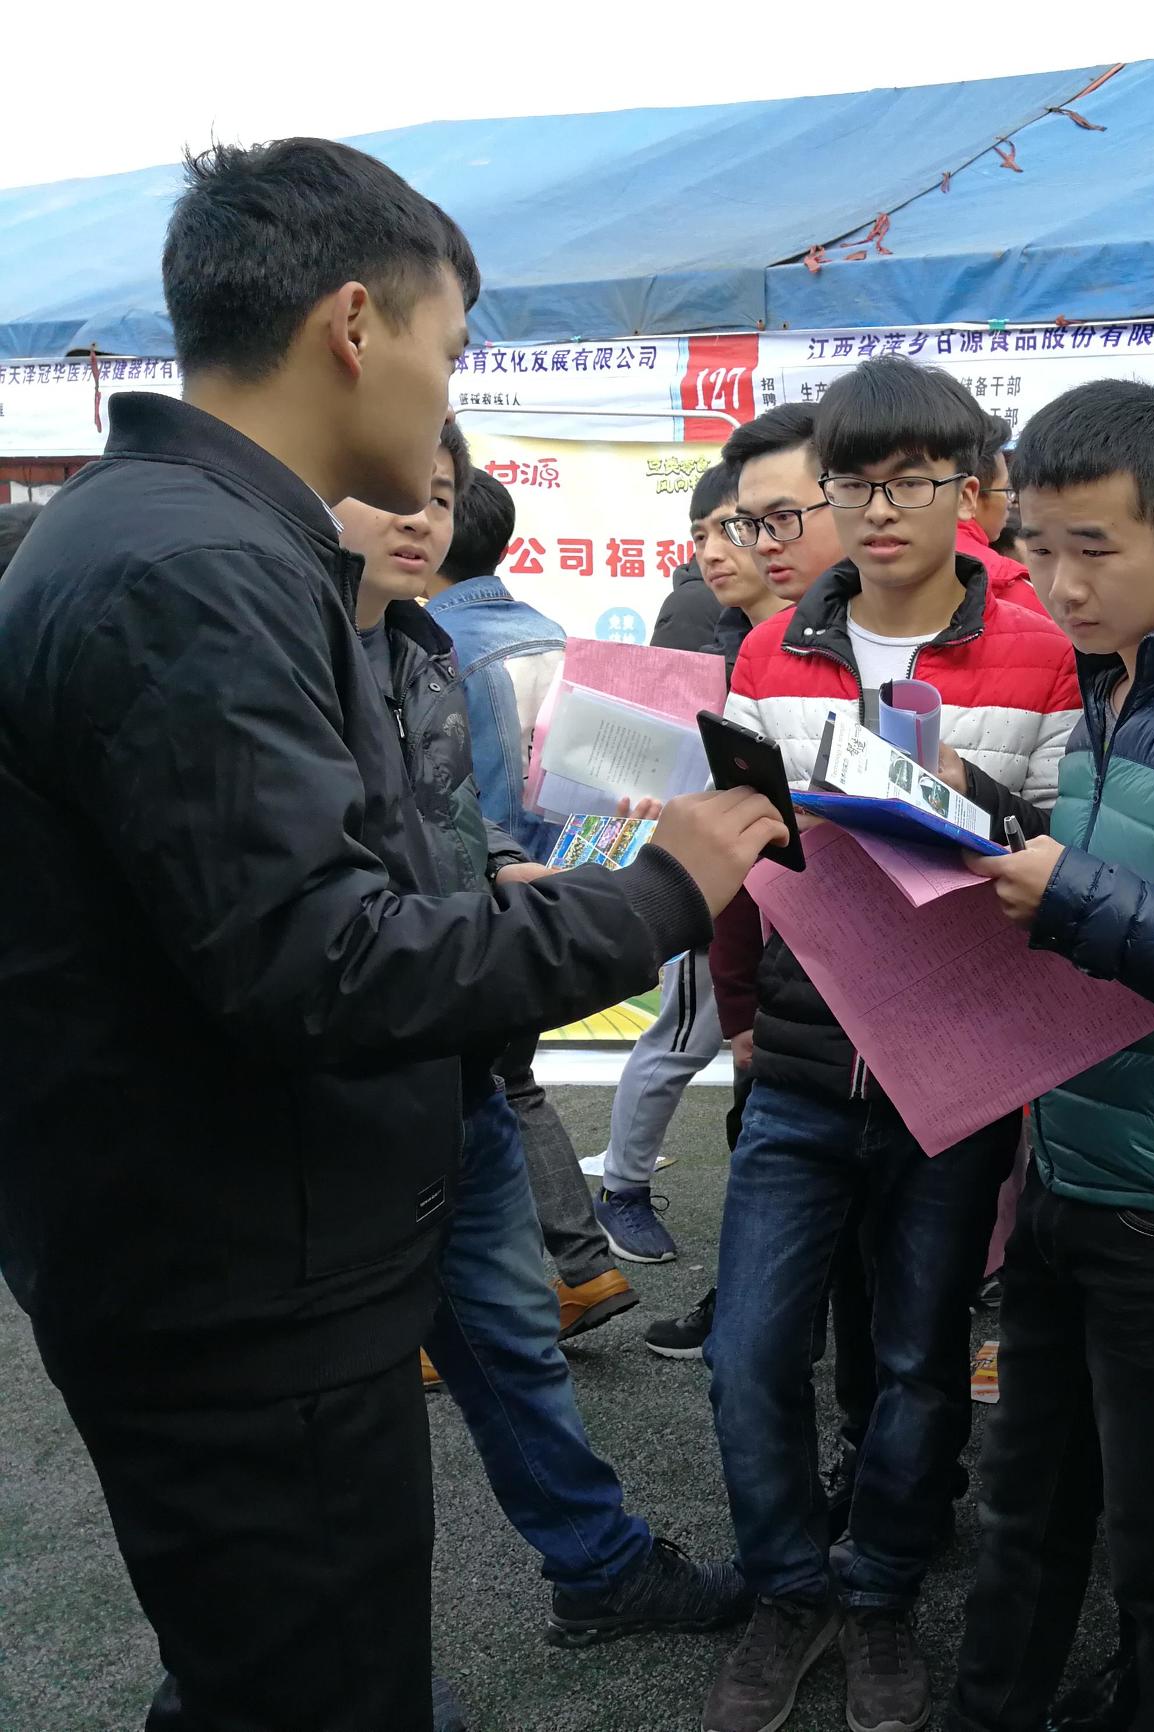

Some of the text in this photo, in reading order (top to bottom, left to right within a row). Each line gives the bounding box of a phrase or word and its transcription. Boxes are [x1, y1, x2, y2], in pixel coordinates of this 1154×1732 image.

[695, 366, 747, 410] 127
[484, 457, 561, 489] 甘源
[506, 536, 696, 578] 公司福利
